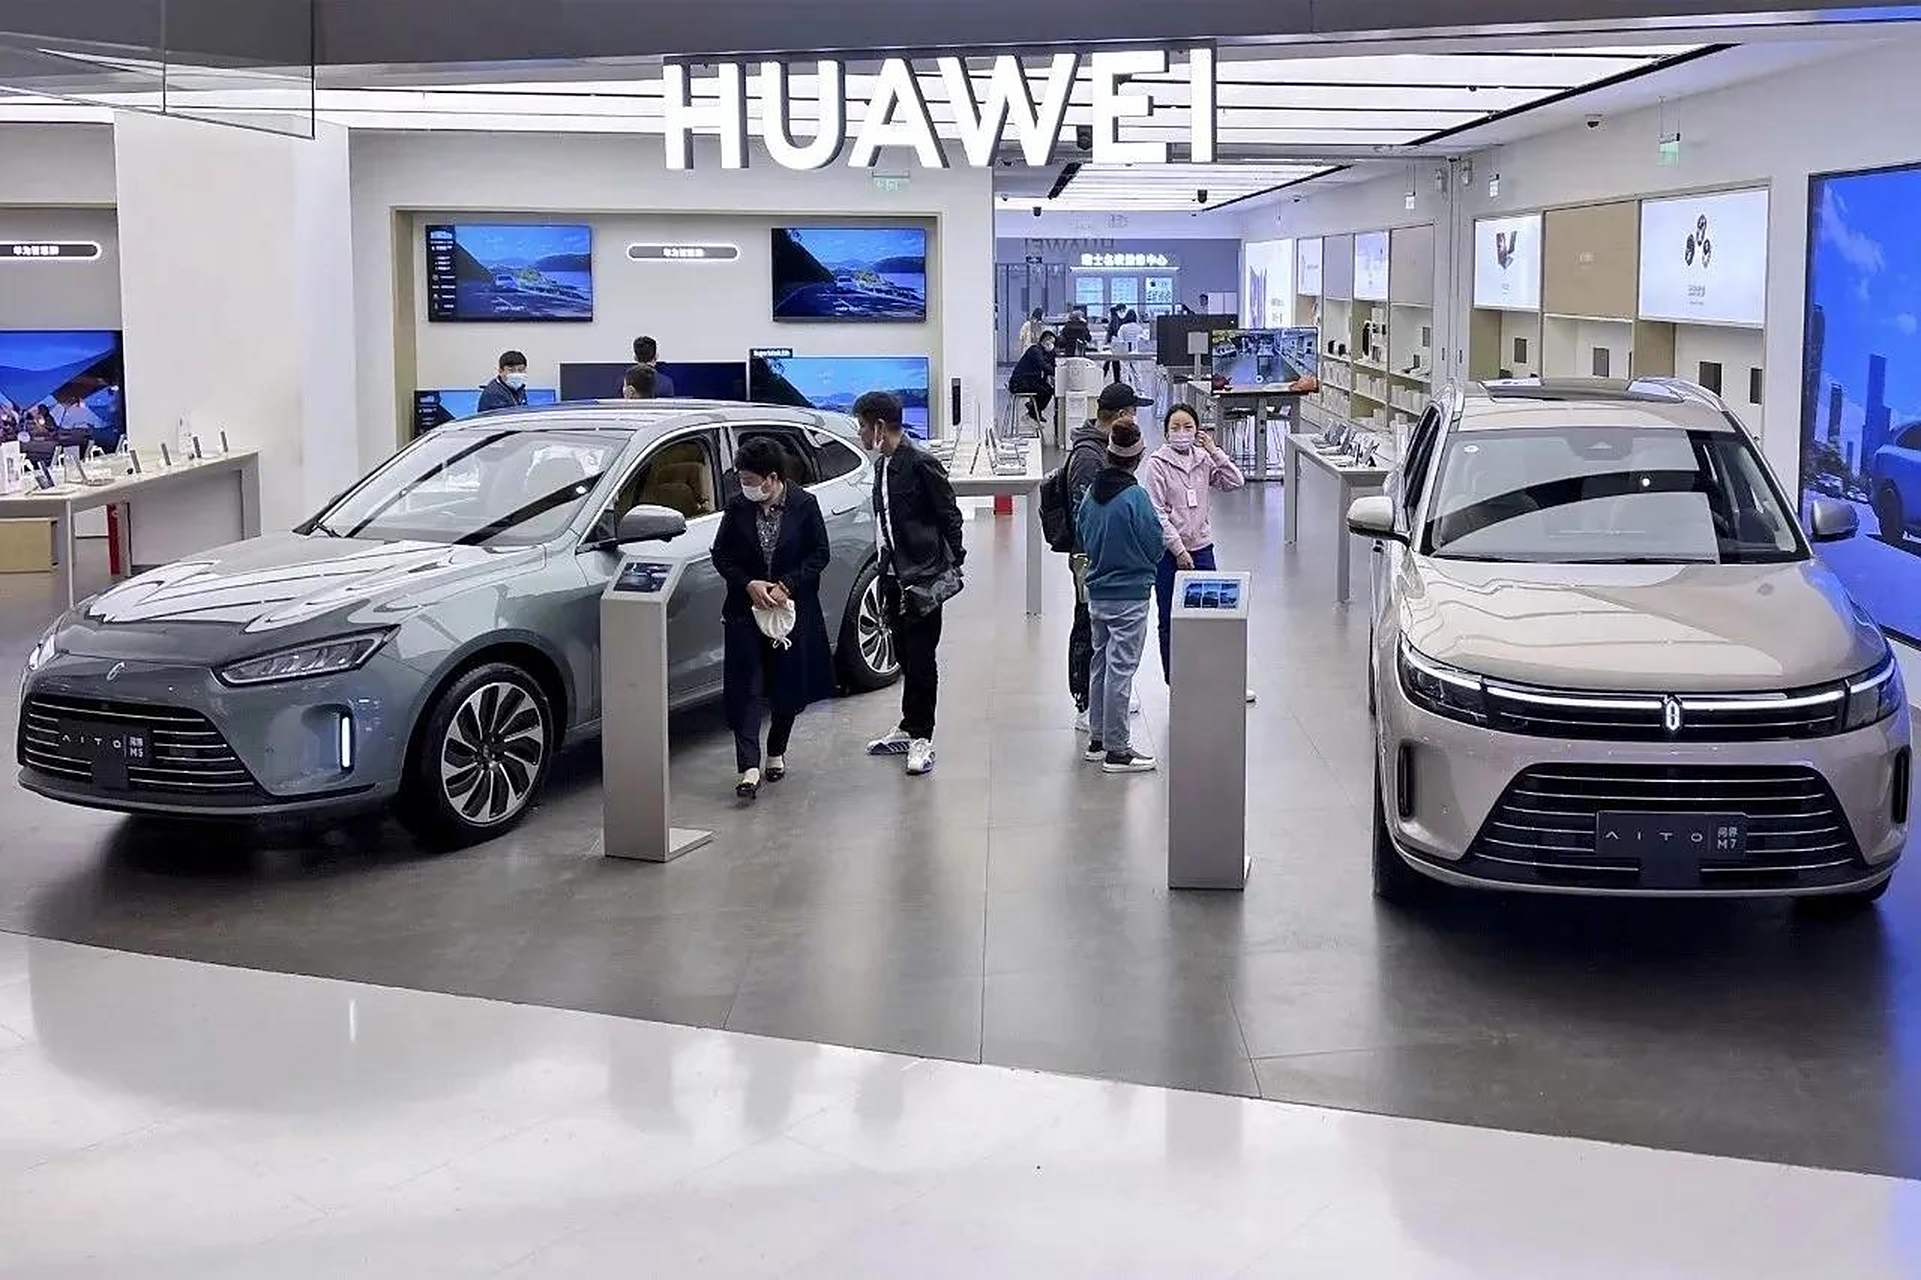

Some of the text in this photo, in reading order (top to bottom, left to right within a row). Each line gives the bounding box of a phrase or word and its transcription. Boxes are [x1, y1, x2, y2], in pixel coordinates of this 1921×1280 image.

[662, 47, 1216, 169] HUAWEI
[62, 734, 121, 748] AITO
[1605, 831, 1703, 842] AITO
[1717, 838, 1737, 849] M7
